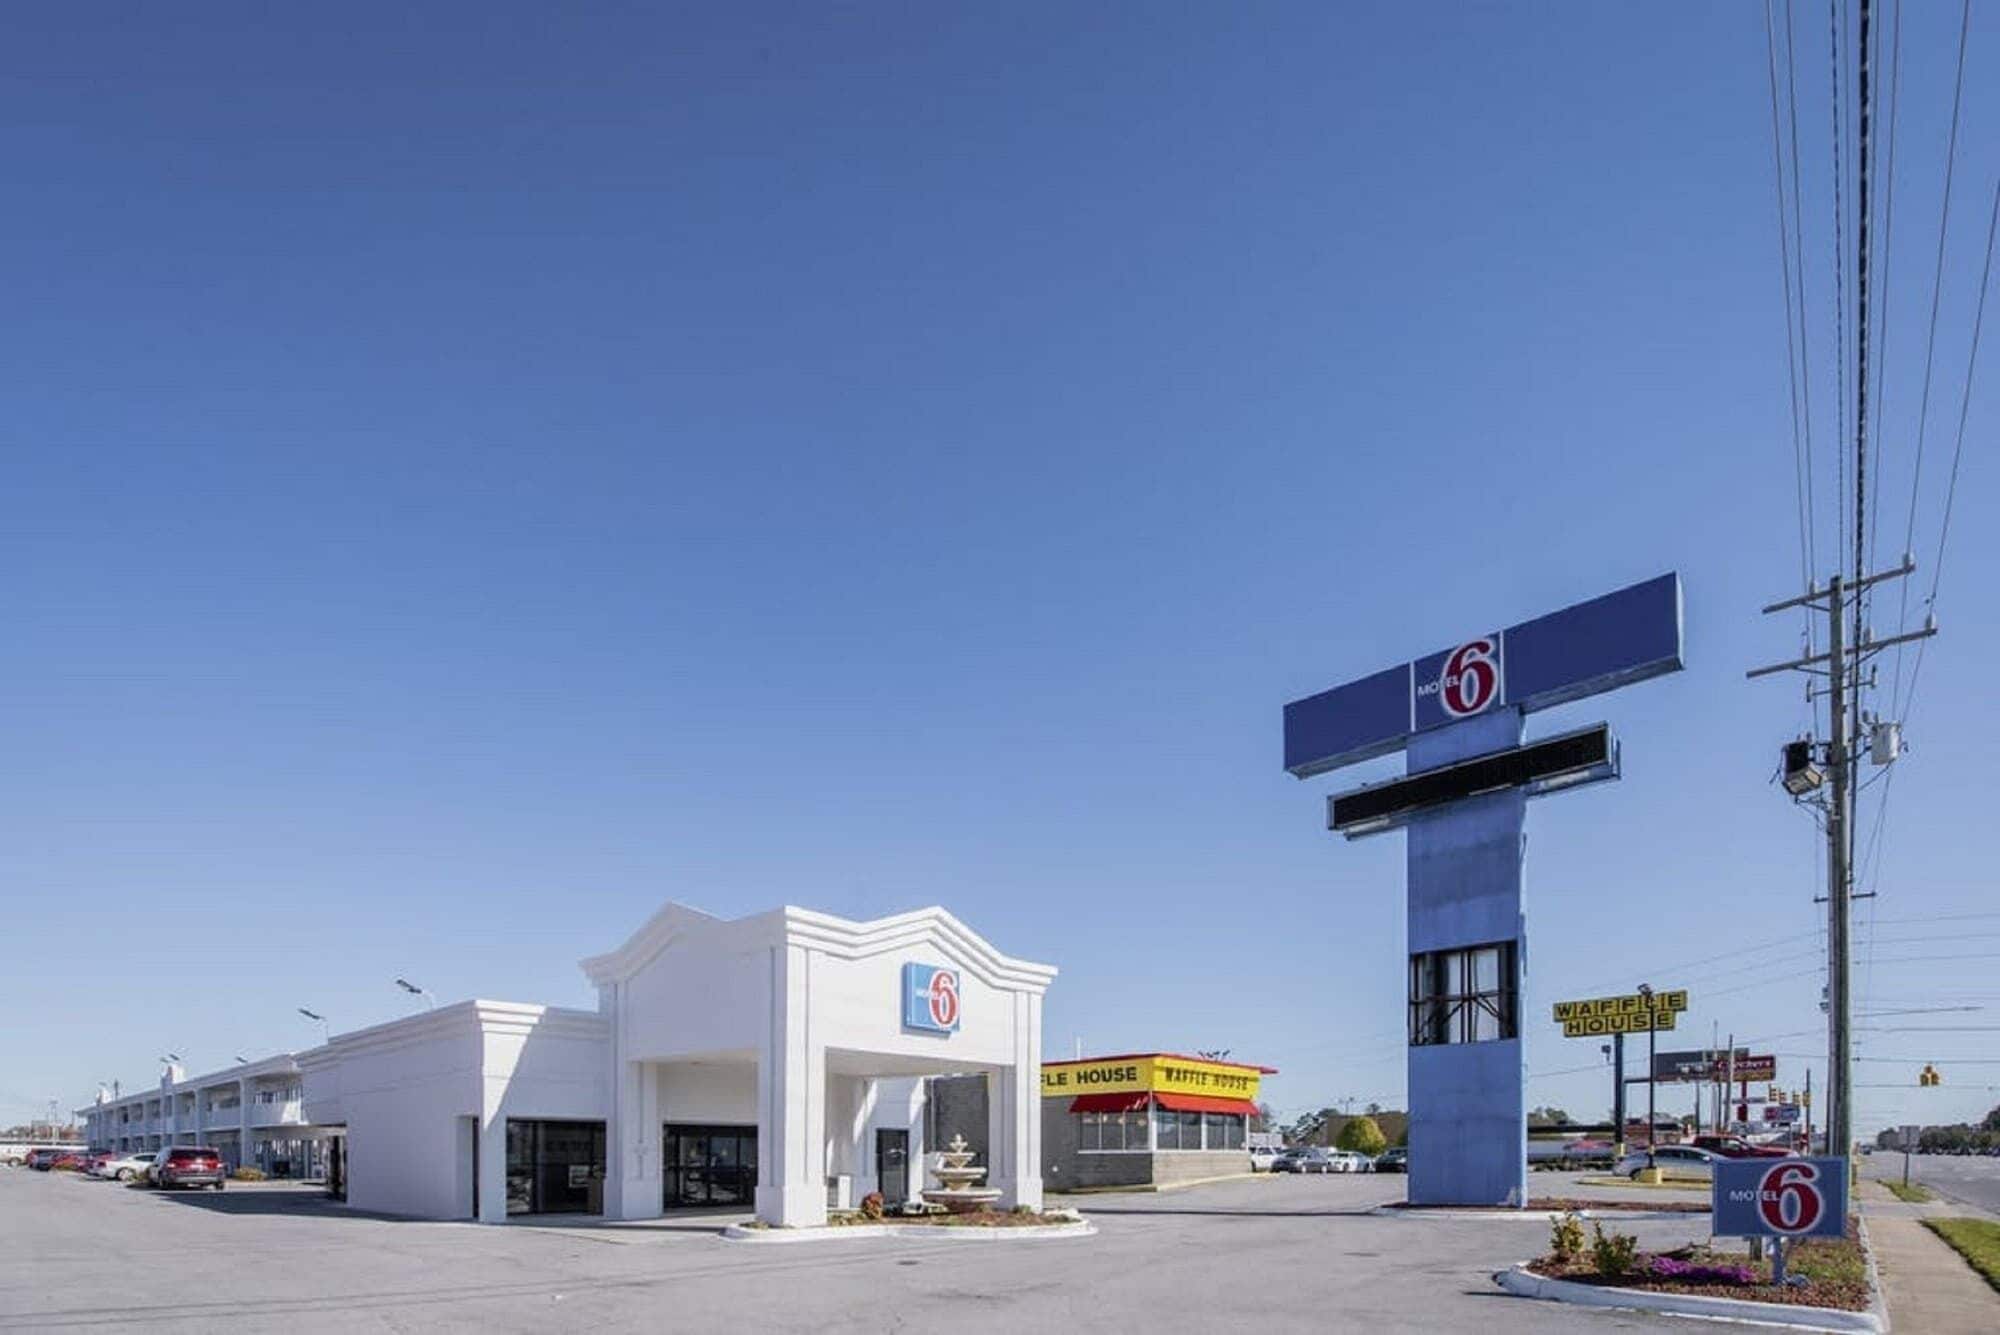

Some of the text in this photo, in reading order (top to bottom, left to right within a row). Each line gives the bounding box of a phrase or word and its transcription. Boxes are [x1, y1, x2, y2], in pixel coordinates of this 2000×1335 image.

[1417, 639, 1498, 717] MOTEL 6
[929, 969, 959, 1028] 6
[1557, 993, 1682, 1017] WAFFLE
[1567, 1011, 1674, 1033] HOUSE
[1076, 1066, 1137, 1085] HOUSE
[1165, 1066, 1208, 1086] WAFFLE
[1729, 1161, 1821, 1233] MOTEL 6
